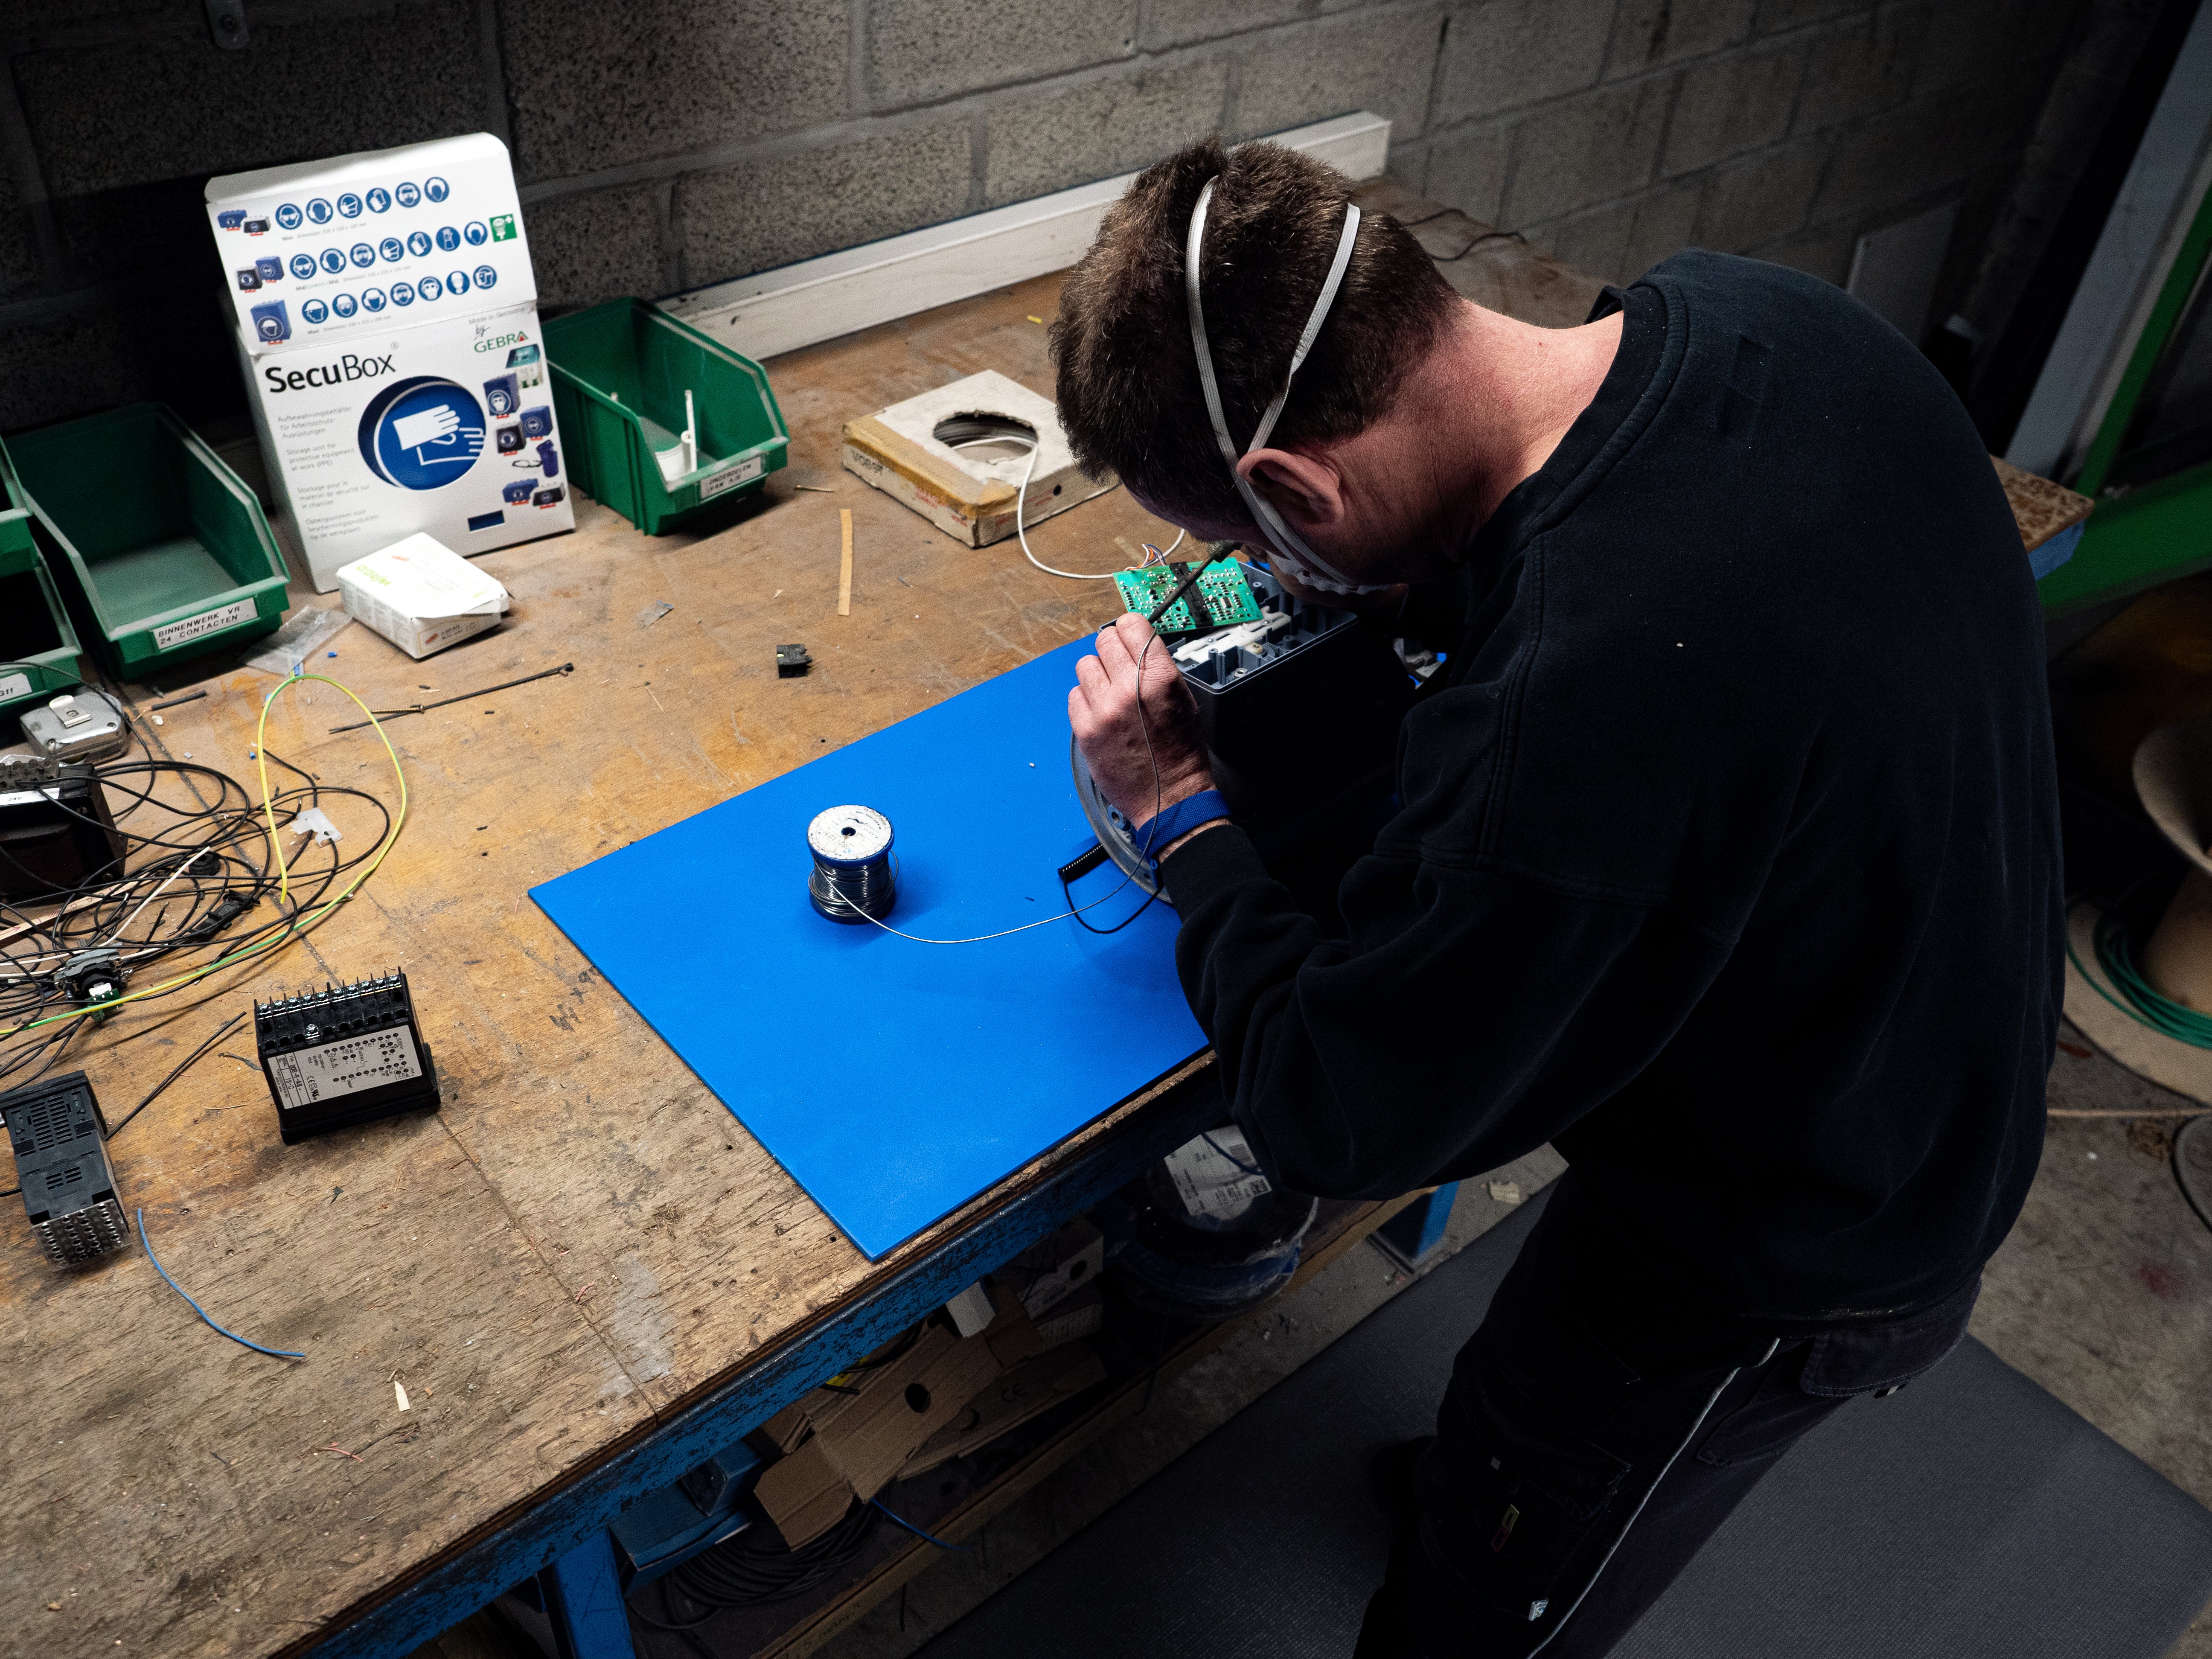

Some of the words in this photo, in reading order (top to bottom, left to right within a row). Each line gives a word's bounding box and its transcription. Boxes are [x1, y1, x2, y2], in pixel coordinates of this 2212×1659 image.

[496, 308, 525, 317] Germany
[472, 322, 492, 340] by
[474, 331, 528, 352] GEBRA
[265, 354, 396, 393] SecuBox
[158, 612, 219, 637] BINNENWERK
[228, 606, 240, 614] VR
[161, 636, 171, 644] 24
[180, 614, 238, 638] CONTACTEN
